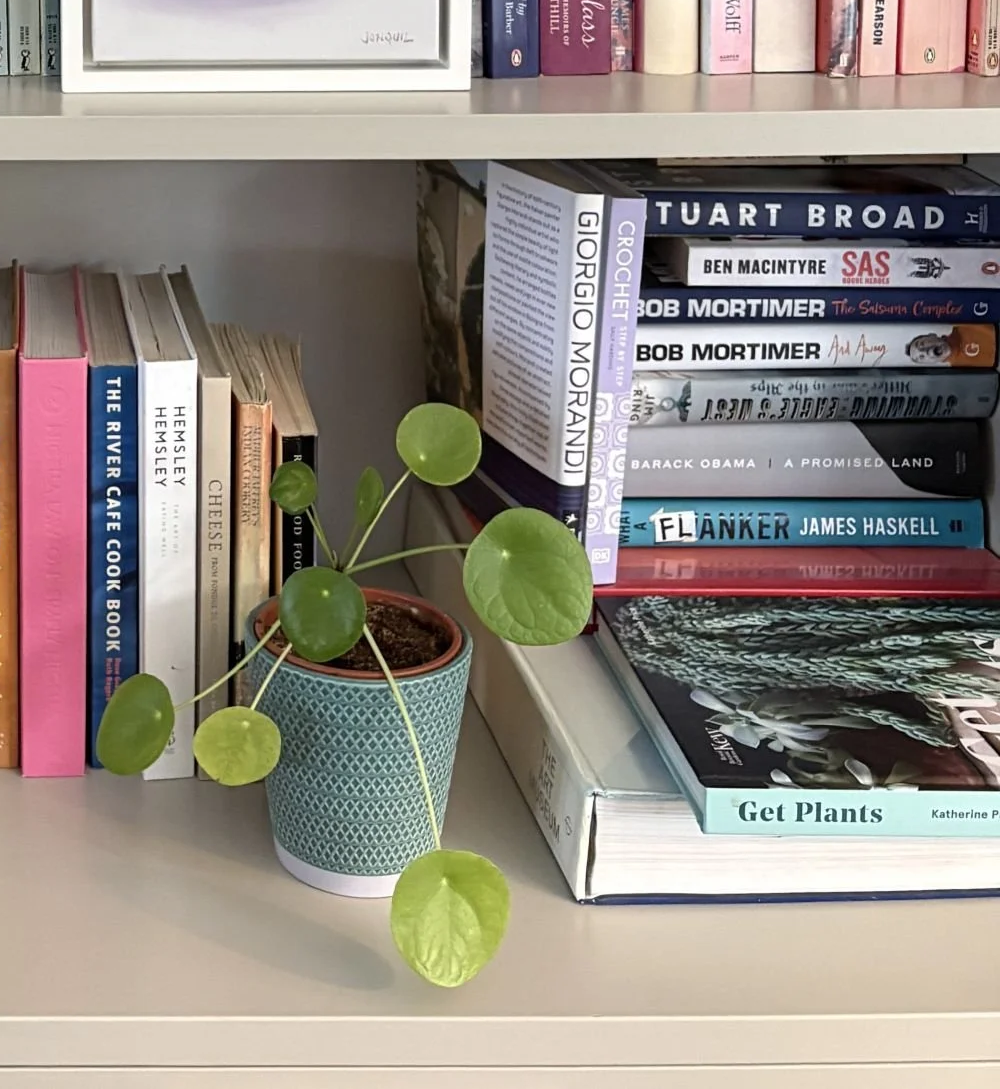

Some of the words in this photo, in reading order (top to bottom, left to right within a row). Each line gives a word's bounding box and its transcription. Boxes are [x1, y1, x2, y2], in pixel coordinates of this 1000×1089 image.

[361, 30, 414, 45] JONQUIL
[505, 3, 515, 34] Barber
[808, 205, 945, 230] BROAD
[572, 211, 599, 331] GIORGIO
[612, 220, 635, 321] CROCHET
[704, 260, 733, 274] BEN
[738, 260, 827, 275] MACINTYRE
[636, 344, 683, 361] BOB
[691, 342, 821, 360] MORTIMER
[106, 377, 120, 413] THE
[564, 342, 591, 474] MORANDI
[106, 422, 121, 478] RIVER
[153, 407, 168, 487] HEMSLEY
[172, 406, 186, 487] HEMSLEY
[631, 459, 693, 470] BARACK
[701, 458, 755, 468] OBAMA
[106, 486, 121, 531] CAFE
[799, 518, 856, 536] JAMES
[863, 517, 939, 535] HASKELL
[106, 539, 121, 591] COOK
[106, 599, 122, 652] BOOK
[739, 801, 786, 822] Get
[795, 801, 883, 823] Plants
